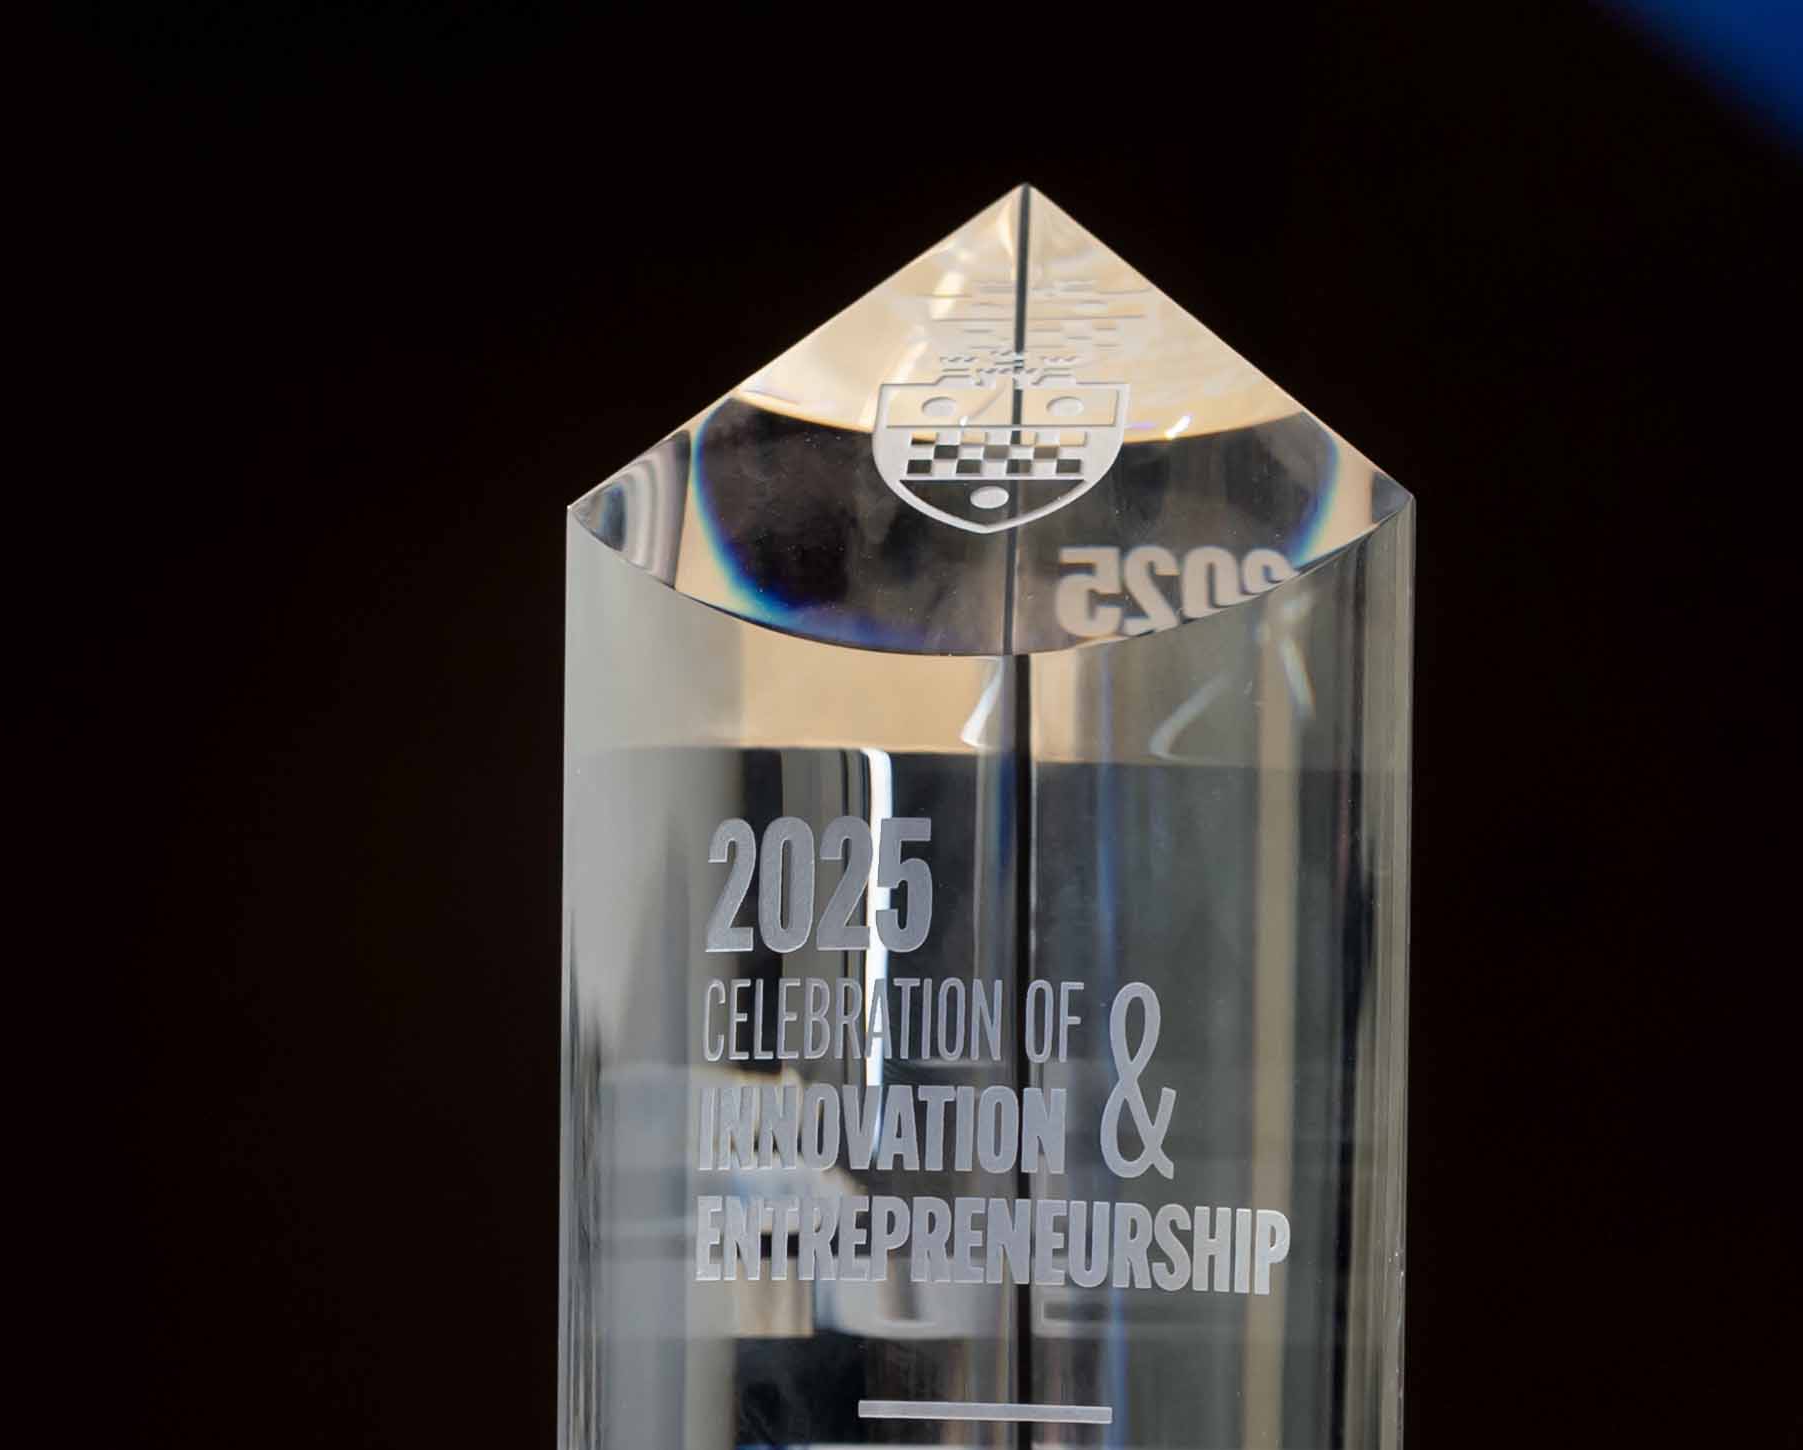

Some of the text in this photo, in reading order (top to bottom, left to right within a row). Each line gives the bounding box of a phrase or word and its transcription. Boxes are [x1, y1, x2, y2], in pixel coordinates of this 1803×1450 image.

[706, 815, 932, 953] 2025
[702, 977, 1085, 1063] CELEBRATION OF
[697, 981, 1176, 1180] INNOVATION &
[696, 1195, 1291, 1296] ENTREPRENEURSHIP
